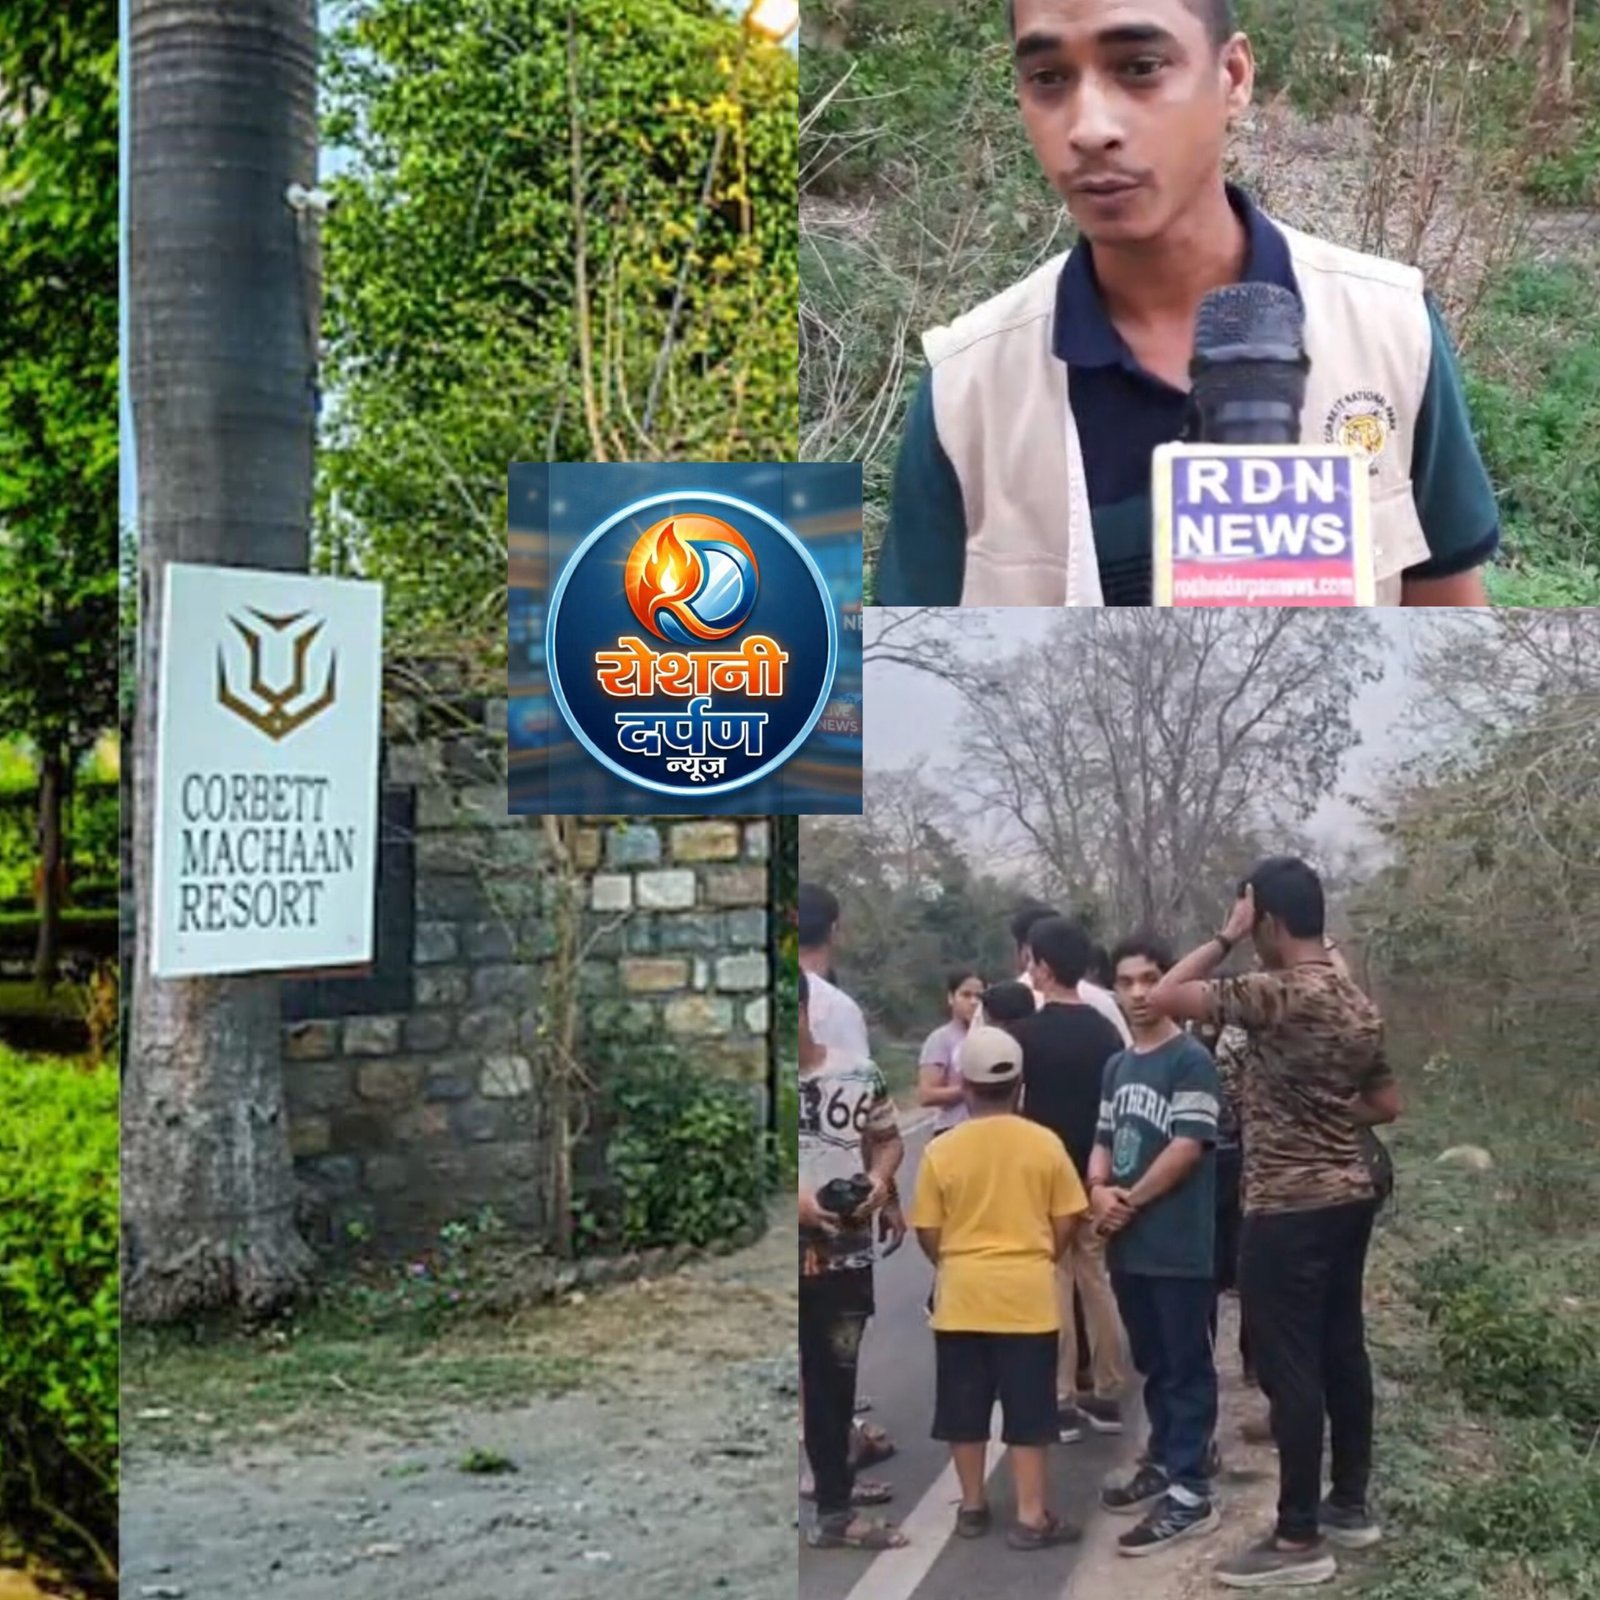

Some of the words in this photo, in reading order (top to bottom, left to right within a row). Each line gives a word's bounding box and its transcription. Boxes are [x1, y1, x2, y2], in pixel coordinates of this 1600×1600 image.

[1187, 458, 1336, 505] RDN
[1177, 512, 1347, 557] NEWS
[181, 773, 329, 823] CORBETT
[180, 827, 355, 878] MACHAAN
[178, 880, 324, 933] RESORT
